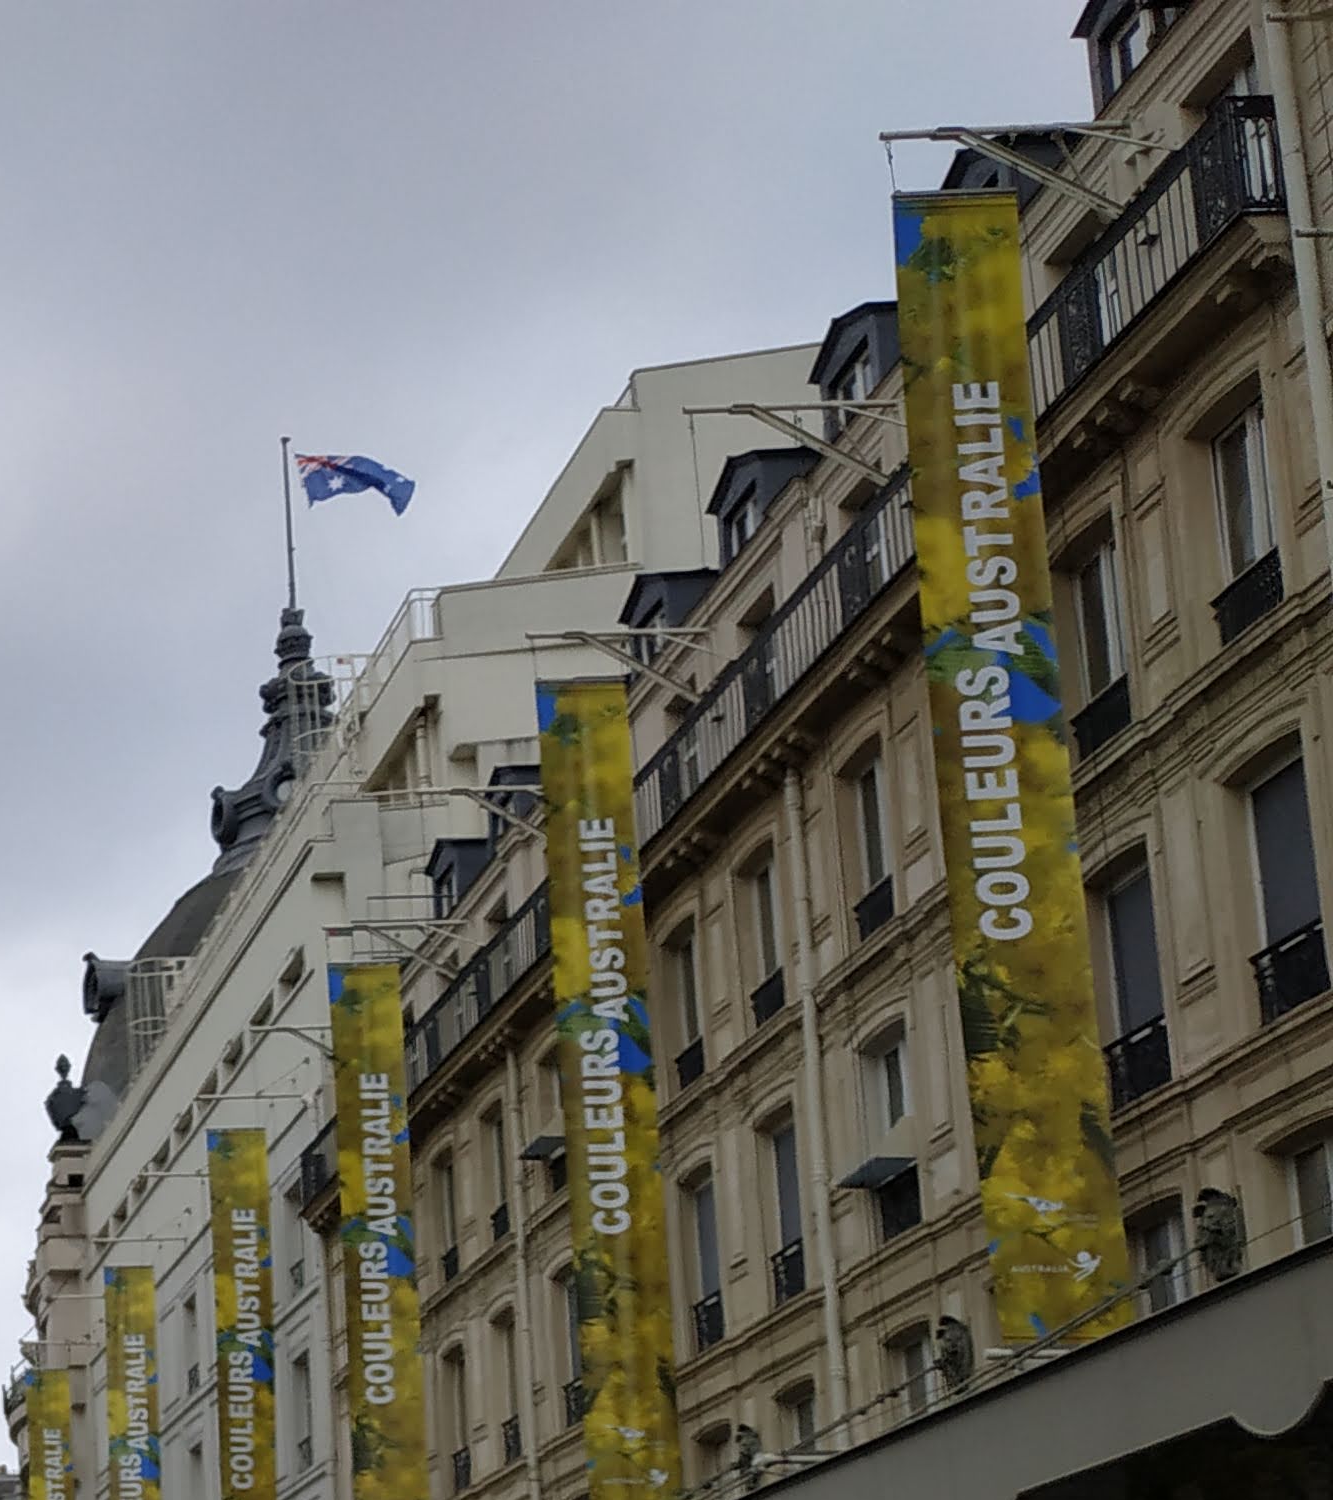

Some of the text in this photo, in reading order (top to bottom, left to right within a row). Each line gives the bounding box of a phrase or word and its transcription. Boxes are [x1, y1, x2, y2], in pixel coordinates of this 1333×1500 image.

[952, 380, 1034, 941] COULEURS AUSTRALIE
[579, 817, 631, 1235] COULEURS AUSTRALIE
[124, 1333, 149, 1450] AUSTRALIE
[228, 1208, 262, 1490] COULEURS AUSTRALIE
[359, 1073, 398, 1405] COULEURS AUSTRALIE
